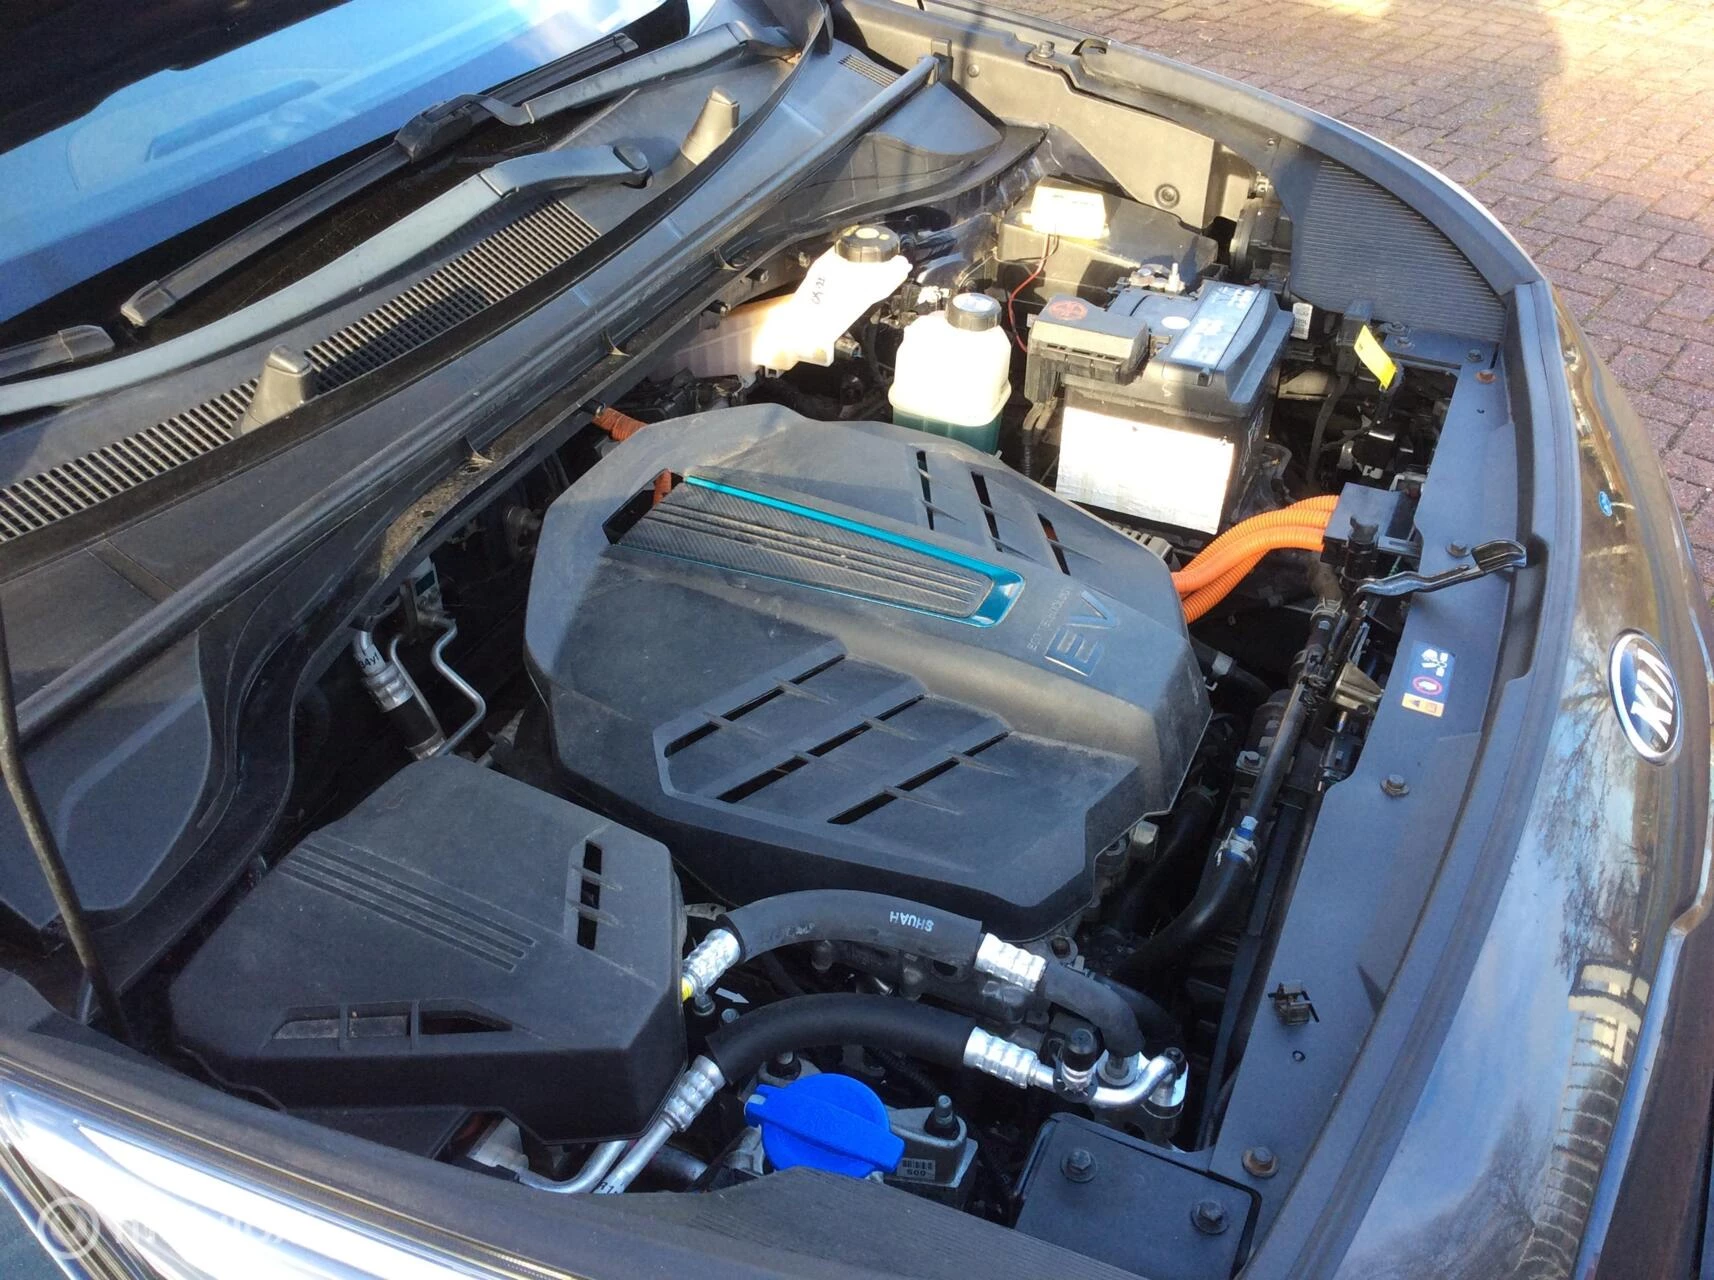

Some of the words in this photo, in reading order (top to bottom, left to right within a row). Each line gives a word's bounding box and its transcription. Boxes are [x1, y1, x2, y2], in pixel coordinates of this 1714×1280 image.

[1043, 588, 1119, 677] EV
[1630, 648, 1674, 744] KIA
[889, 911, 934, 932] SHUAH
